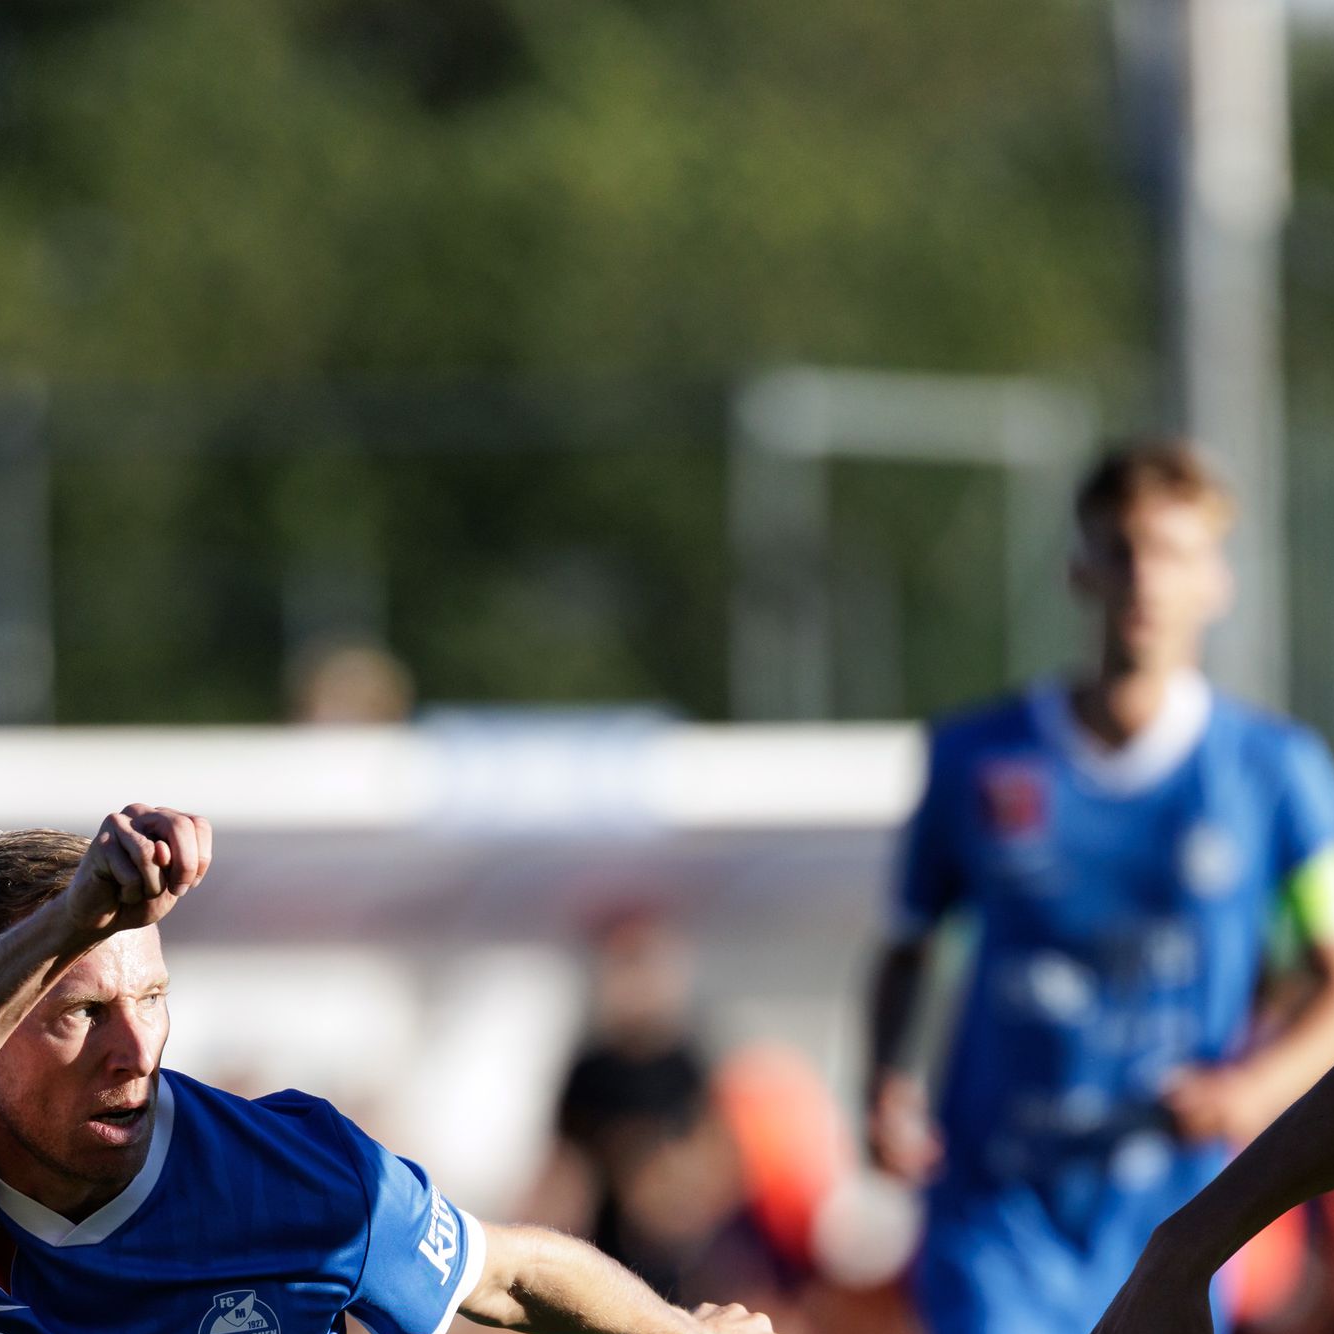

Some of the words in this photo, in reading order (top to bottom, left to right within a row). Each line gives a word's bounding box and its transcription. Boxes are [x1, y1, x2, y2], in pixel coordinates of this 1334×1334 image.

[219, 1296, 235, 1309] FC
[234, 1308, 246, 1319] M
[247, 1319, 264, 1329] 1927
